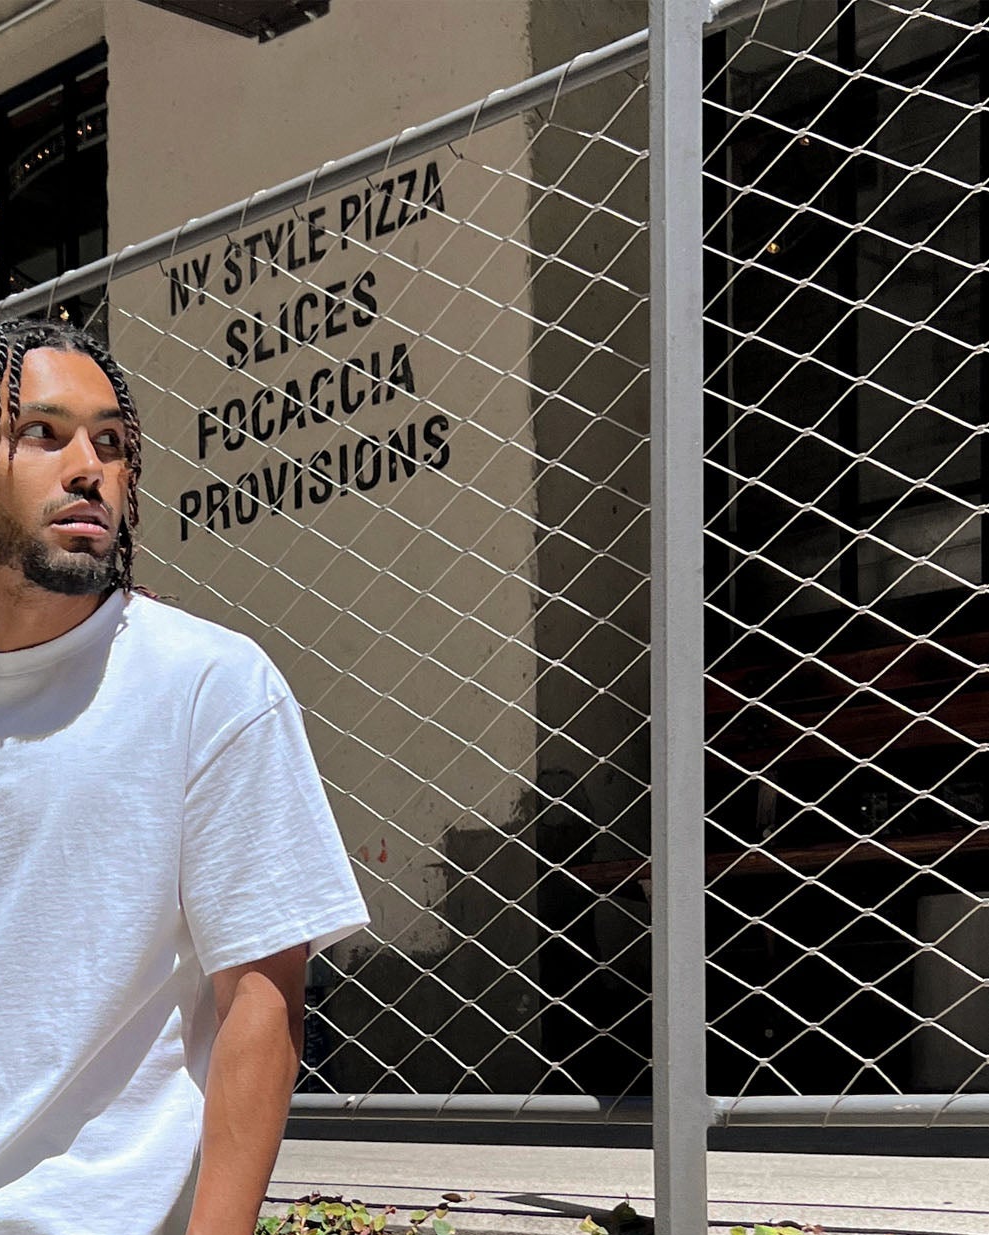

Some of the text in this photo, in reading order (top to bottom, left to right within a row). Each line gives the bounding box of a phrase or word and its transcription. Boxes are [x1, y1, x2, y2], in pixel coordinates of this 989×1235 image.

[168, 161, 446, 316] NY STYLE PIZZA
[225, 270, 378, 372] SLICES
[197, 342, 416, 460] FOCACCIA
[179, 414, 451, 542] PROVISIONS
